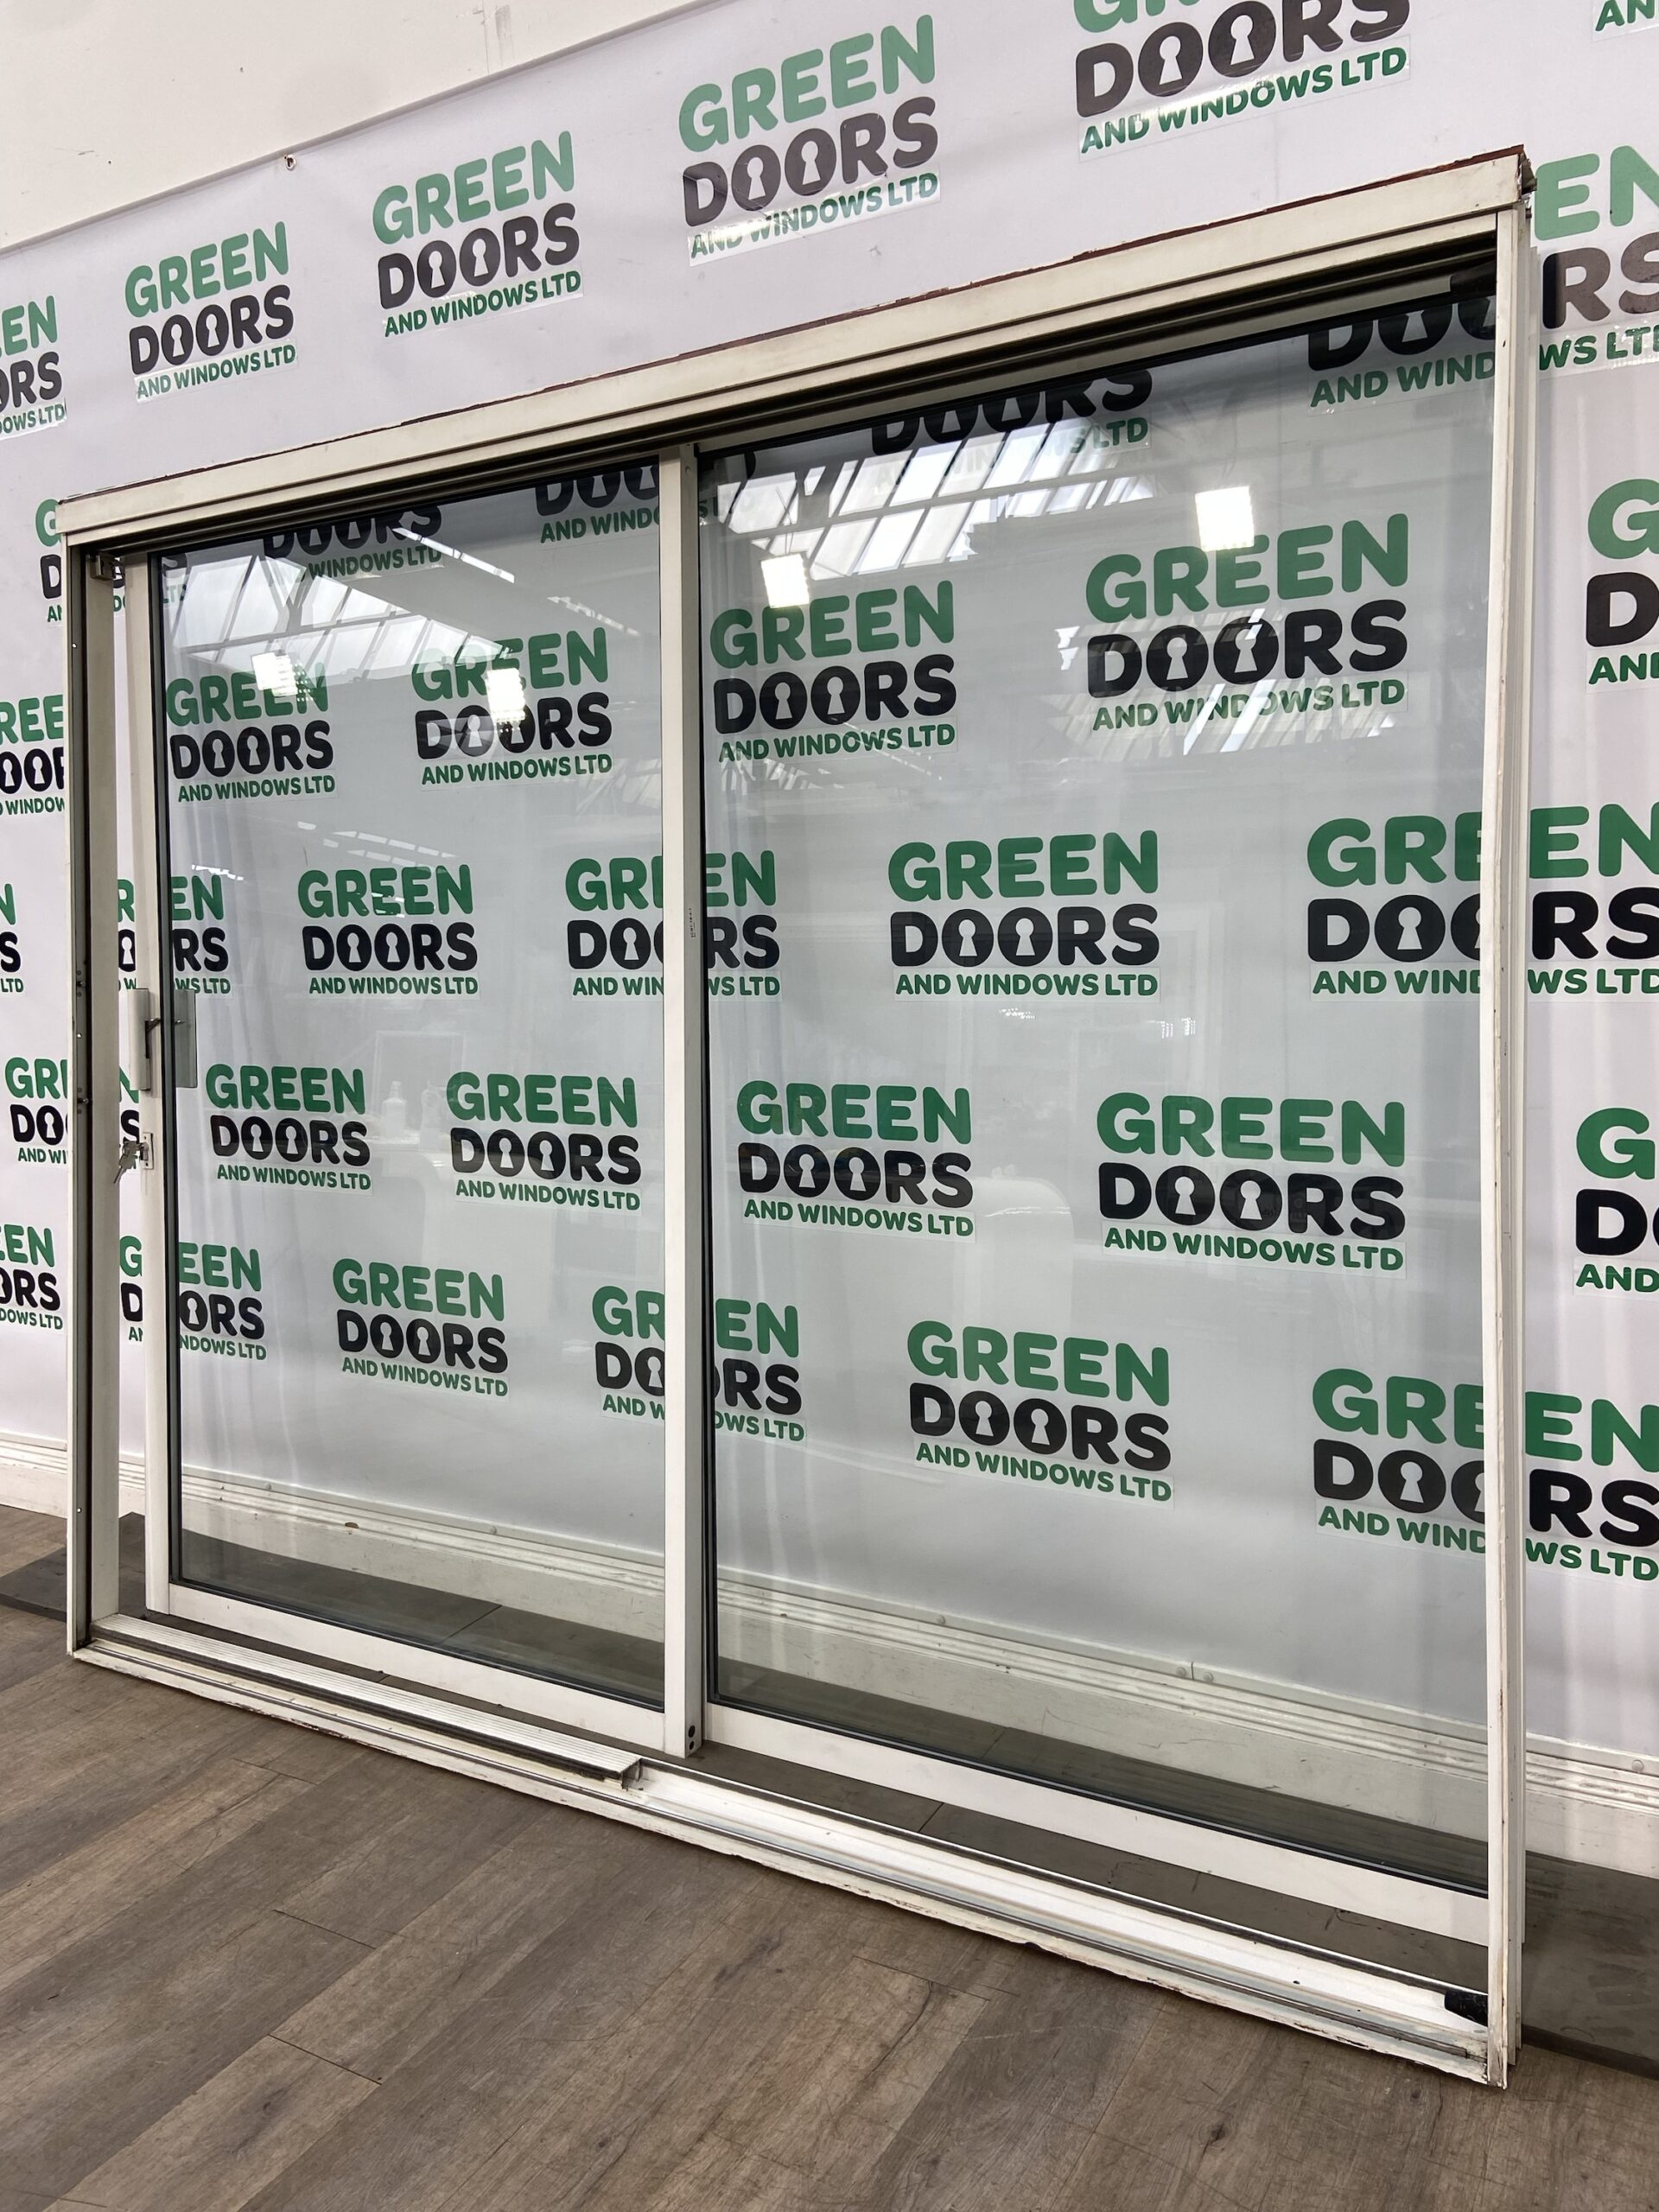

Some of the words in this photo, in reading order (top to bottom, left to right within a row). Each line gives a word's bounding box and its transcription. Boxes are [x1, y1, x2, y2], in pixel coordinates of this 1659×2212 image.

[1595, 0, 1659, 31] AN
[678, 14, 935, 152] GREEN
[1076, 0, 1410, 118] DOORS
[1081, 111, 1149, 154] AND
[1157, 66, 1332, 132] WINDOWS
[1342, 47, 1407, 85] LTD
[372, 131, 576, 245] GREEN
[683, 97, 938, 226] DOORS
[691, 229, 743, 258] AND
[750, 187, 882, 240] WINDOWS
[888, 173, 938, 206] LTD
[125, 221, 289, 317] GREEN
[378, 202, 580, 309] DOORS
[0, 296, 57, 356] EN
[129, 285, 294, 374] DOORS
[385, 309, 428, 337] AND
[431, 284, 537, 326] WINDOWS
[541, 270, 581, 298] LTD
[137, 373, 172, 398] AND
[175, 355, 260, 389] WINDOWS
[264, 344, 296, 367] LTD
[1311, 372, 1389, 407] AND
[1607, 324, 1659, 359] LT
[0, 410, 35, 434] OWS
[38, 404, 65, 424] LTD
[1092, 417, 1148, 449] LTD
[540, 516, 587, 543] AND
[309, 547, 404, 580] WINDOWS
[1086, 513, 1408, 622] GREEN
[710, 581, 954, 669] GREEN
[1087, 599, 1408, 697] DOORS
[412, 627, 607, 701] GREEN
[0, 695, 64, 745] REE
[167, 663, 328, 727] GREEN
[714, 653, 957, 734] DOORS
[1092, 705, 1158, 731] AND
[1164, 685, 1334, 723] WINDOWS
[1341, 679, 1405, 707] LTD
[169, 720, 333, 779] DOORS
[415, 692, 612, 760] DOORS
[719, 739, 769, 763] AND
[773, 728, 902, 758] WINDOWS
[908, 724, 955, 747] LTD
[178, 785, 213, 802] AND
[214, 778, 302, 800] WINDOWS
[303, 775, 335, 793] LTD
[422, 766, 464, 785] AND
[468, 758, 570, 782] WINDOWS
[575, 754, 612, 774] LTD
[5, 797, 64, 816] WINDOW
[298, 864, 473, 918] GREEN
[888, 830, 1158, 902] GREEN
[302, 922, 478, 971] DOORS
[890, 904, 1160, 967] DOORS
[1, 978, 24, 993] LTD
[203, 978, 231, 994] LTD
[308, 976, 346, 994] AND
[348, 977, 442, 994] WINDOWS
[445, 976, 478, 994] LTD
[573, 977, 619, 995] AND
[740, 976, 780, 995] LTD
[896, 975, 951, 995] AND
[957, 974, 1099, 995] WINDOWS
[1104, 974, 1158, 995] LTD
[1313, 969, 1387, 994] AND
[1597, 969, 1659, 994] LTD
[206, 1064, 365, 1114] GREEN
[447, 1071, 638, 1128] GREEN
[737, 1080, 972, 1145] GREEN
[18, 1147, 46, 1162] AND
[210, 1115, 370, 1166] DOORS
[450, 1127, 641, 1185] DOORS
[1096, 1092, 1405, 1167] GREEN
[217, 1164, 251, 1181] AND
[252, 1168, 337, 1187] WINDOWS
[340, 1172, 371, 1190] LTD
[455, 1179, 495, 1198] AND
[498, 1182, 600, 1207] WINDOWS
[603, 1190, 640, 1211] LTD
[738, 1142, 973, 1208] DOORS
[1099, 1162, 1405, 1240] DOORS
[0, 1224, 54, 1268] EN
[744, 1199, 793, 1220] AND
[798, 1204, 923, 1232] WINDOWS
[927, 1213, 974, 1236] LTD
[1104, 1228, 1167, 1251] AND
[1173, 1233, 1336, 1266] WINDOWS
[1343, 1244, 1403, 1271] LTD
[1576, 1264, 1659, 1292] AND
[333, 1258, 505, 1321] GREEN
[40, 1313, 63, 1330] LTD
[337, 1309, 508, 1373] DOORS
[238, 1342, 267, 1360] LTD
[342, 1357, 378, 1377] AND
[381, 1362, 472, 1392] WINDOWS
[475, 1376, 508, 1396] LTD
[907, 1320, 1170, 1407] GREEN
[602, 1394, 645, 1416] AND
[764, 1418, 804, 1441] LTD
[909, 1382, 1172, 1471] DOORS
[916, 1442, 970, 1468] AND
[976, 1451, 1113, 1493] WINDOWS
[1120, 1475, 1172, 1502] LTD
[1318, 1506, 1389, 1536] AND
[1590, 1549, 1659, 1581] LTD
